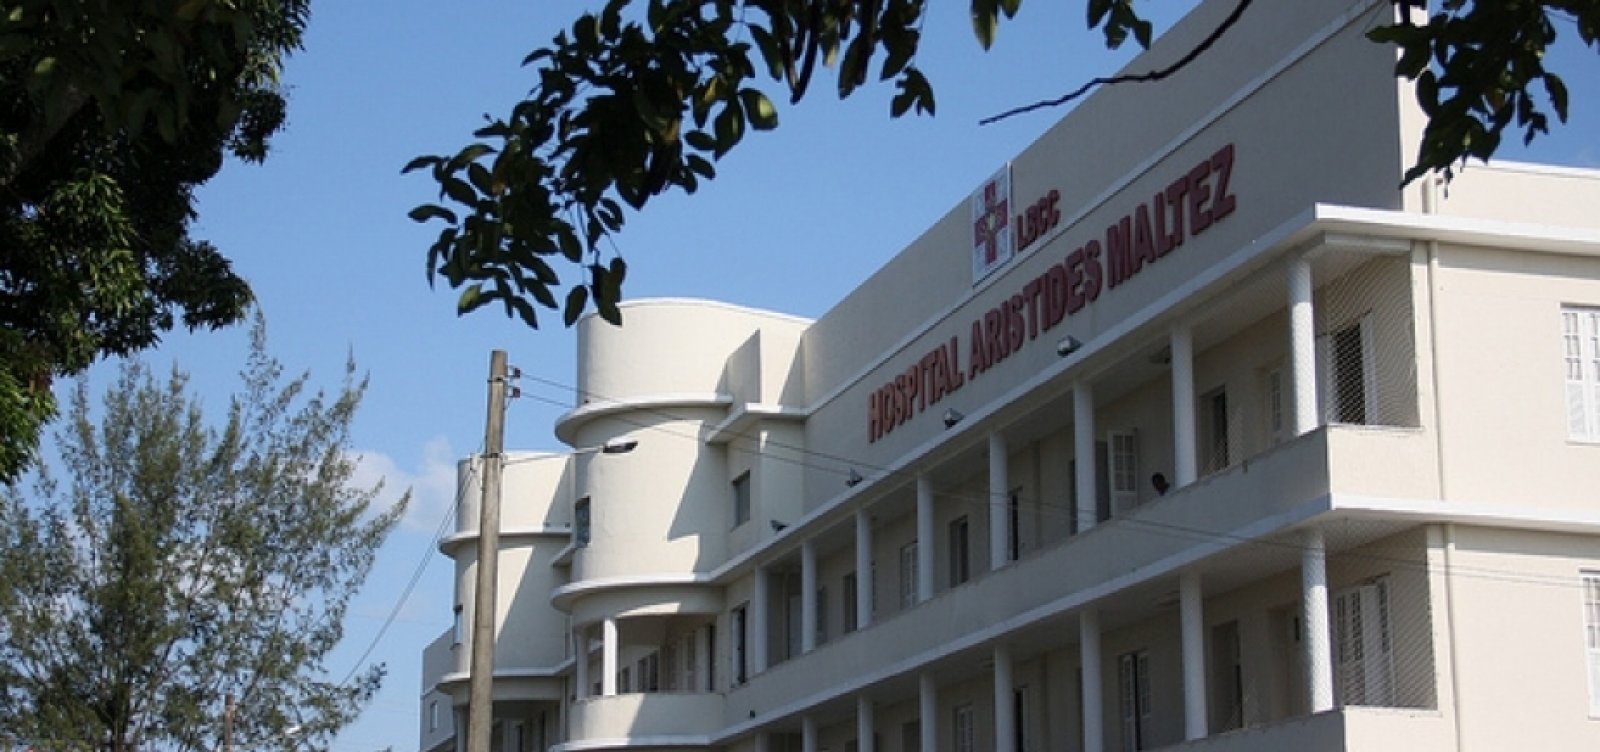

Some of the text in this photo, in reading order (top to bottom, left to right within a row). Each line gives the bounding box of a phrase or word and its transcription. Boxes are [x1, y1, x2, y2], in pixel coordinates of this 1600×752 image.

[868, 143, 1236, 443] HOSPITAL ARISTIDES MALTEZ
[1017, 189, 1060, 251] LBCC
